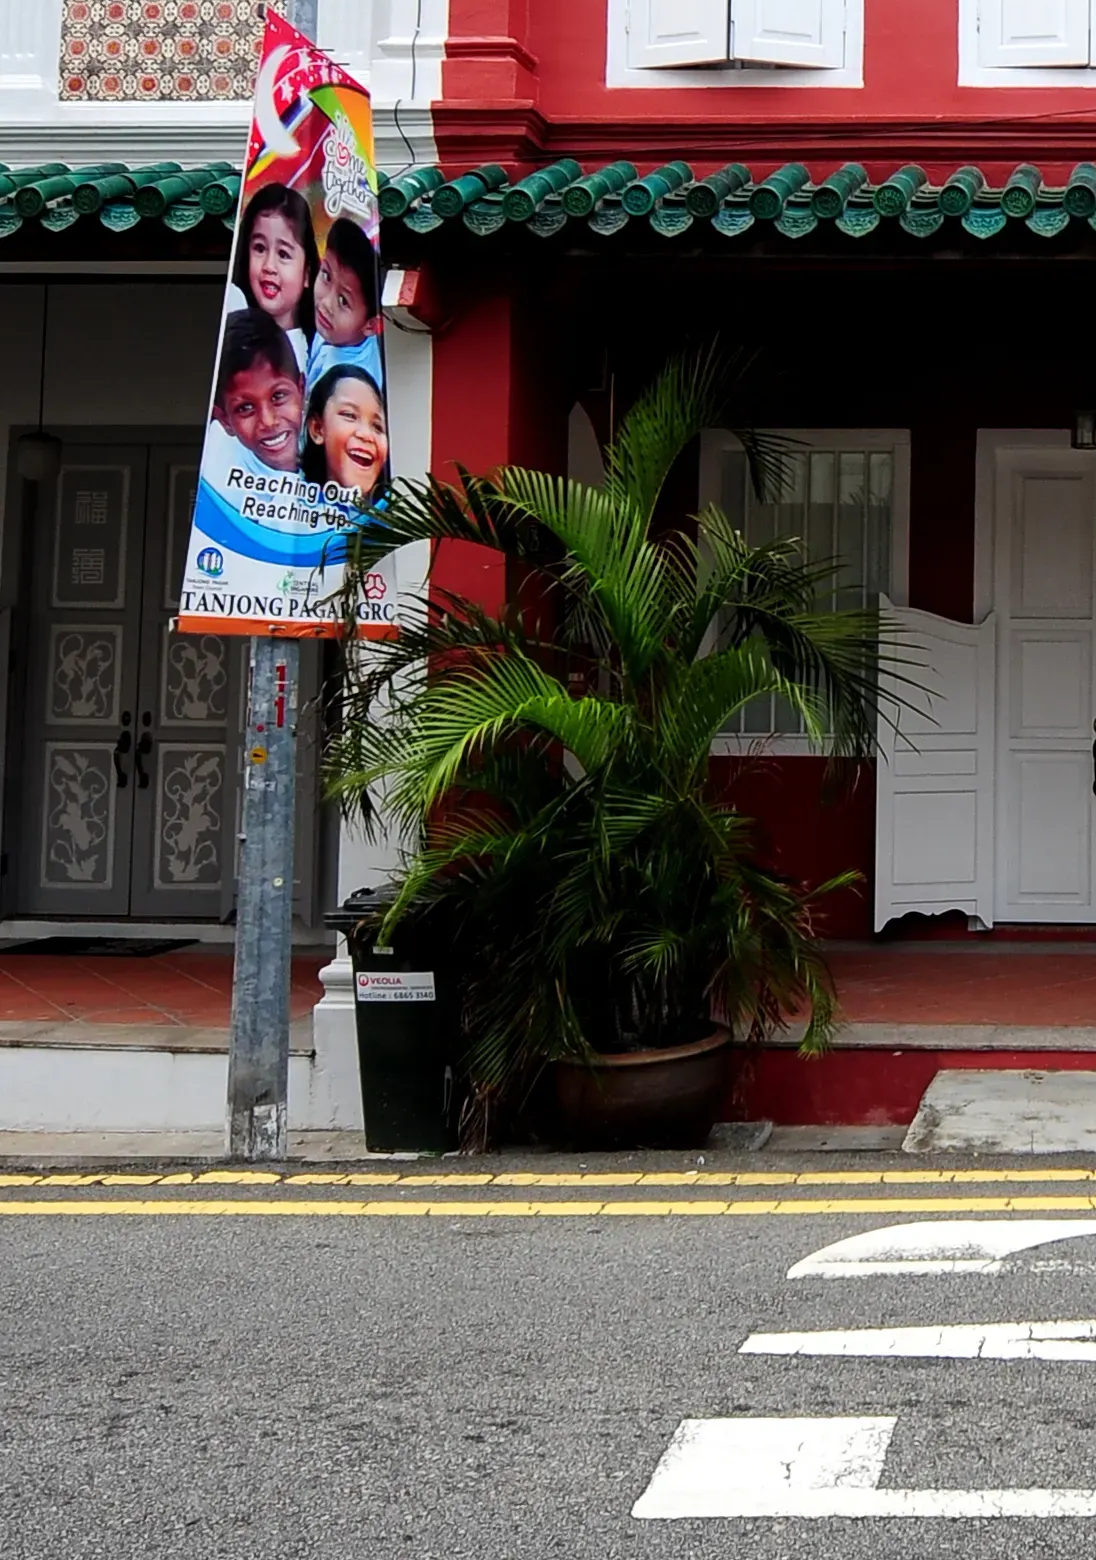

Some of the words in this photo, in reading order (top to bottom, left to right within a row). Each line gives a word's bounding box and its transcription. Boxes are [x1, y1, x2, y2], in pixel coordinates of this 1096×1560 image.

[227, 469, 318, 503] Reaching
[243, 496, 319, 528] Reaching
[182, 591, 283, 616] TANJONG
[357, 602, 394, 621] GRC
[359, 991, 386, 999] Hotline
[370, 977, 402, 985] VEOLIA
